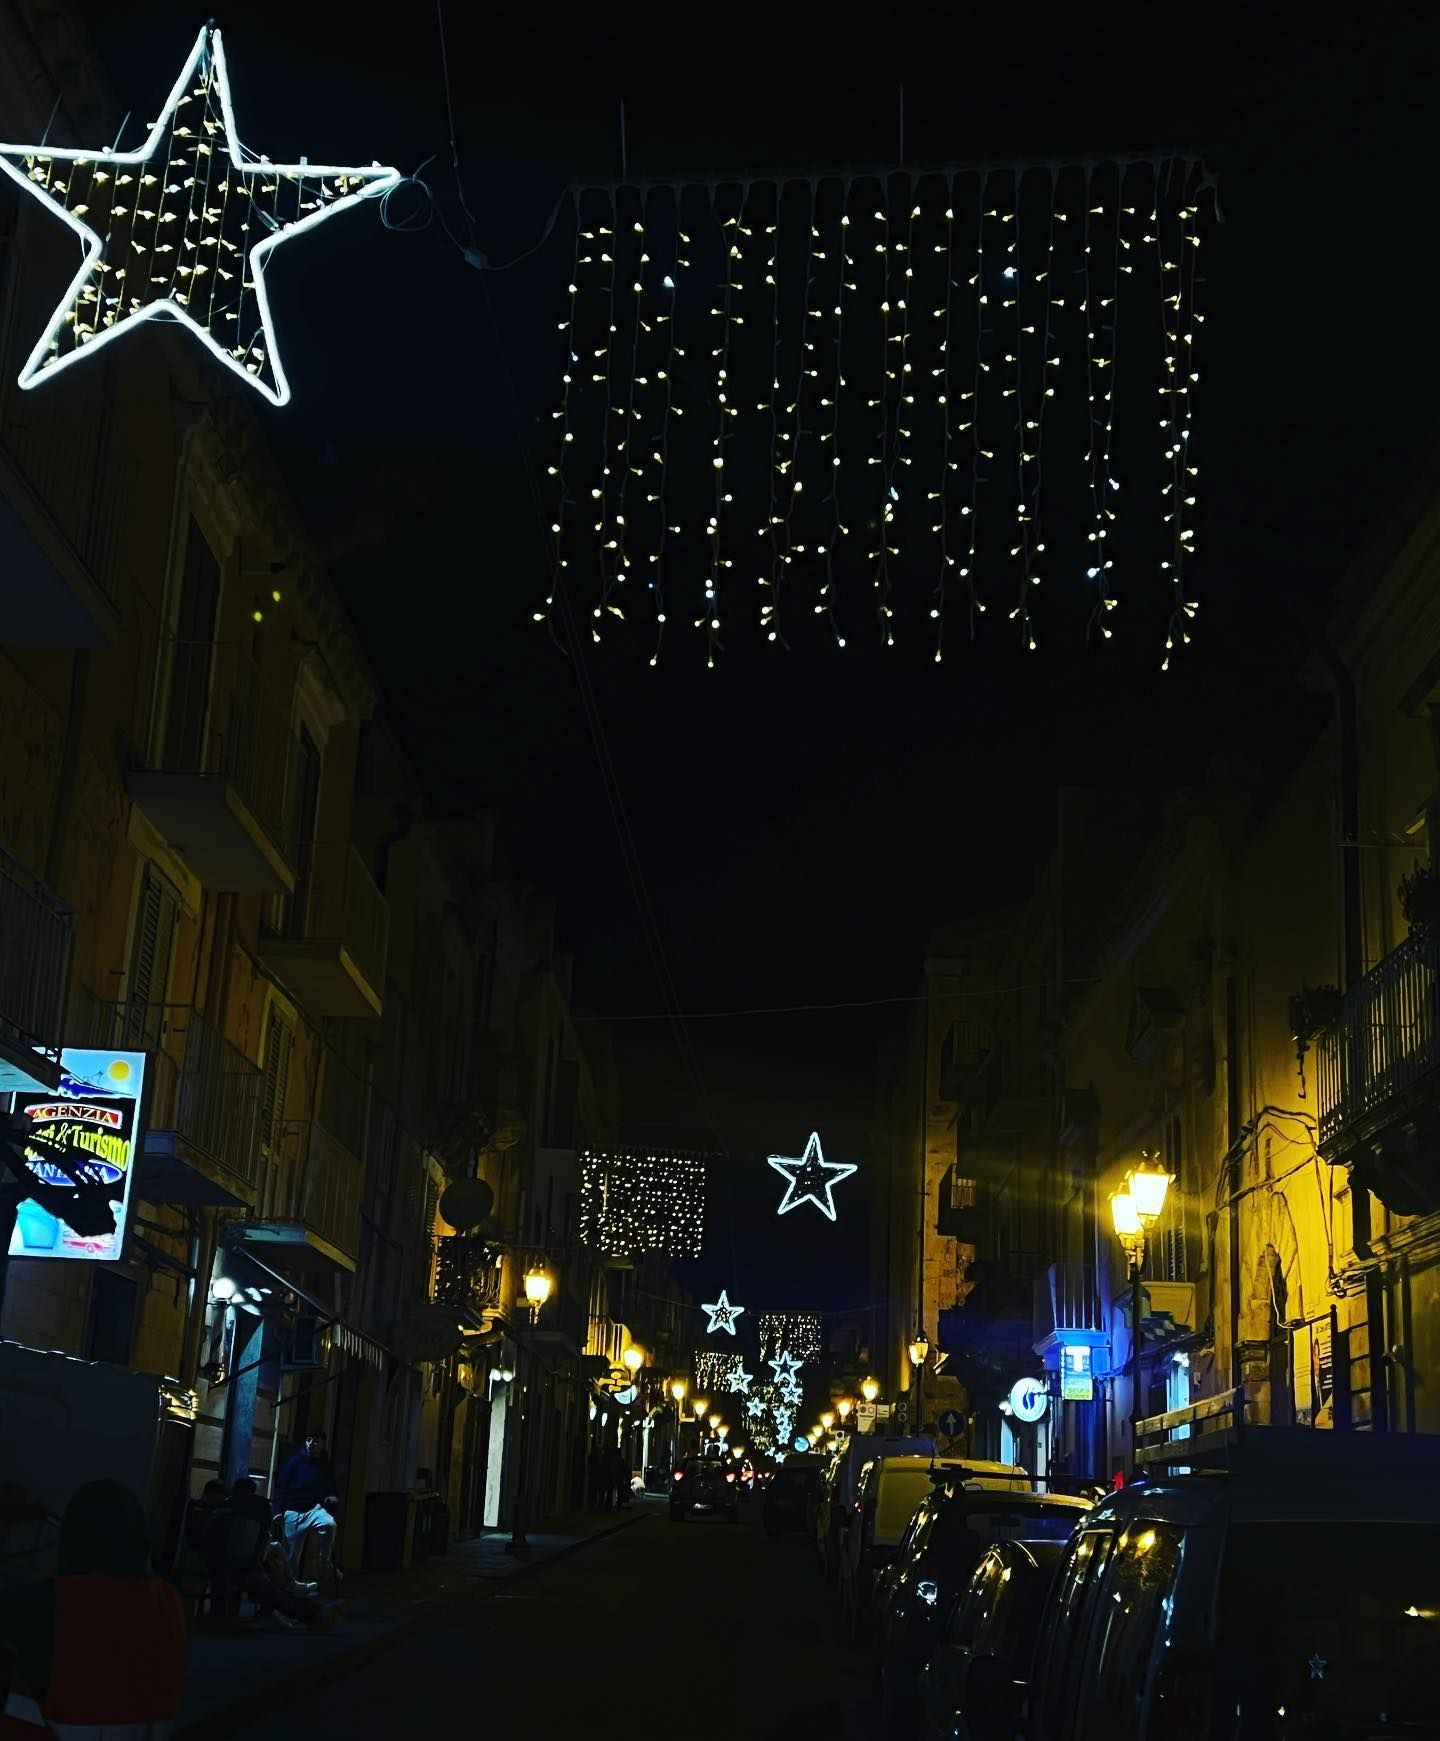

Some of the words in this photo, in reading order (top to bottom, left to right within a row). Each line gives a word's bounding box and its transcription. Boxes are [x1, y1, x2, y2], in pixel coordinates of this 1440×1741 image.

[32, 1105, 115, 1125] AGENZIA
[72, 1123, 131, 1172] Turismo
[1065, 1345, 1091, 1372] T
